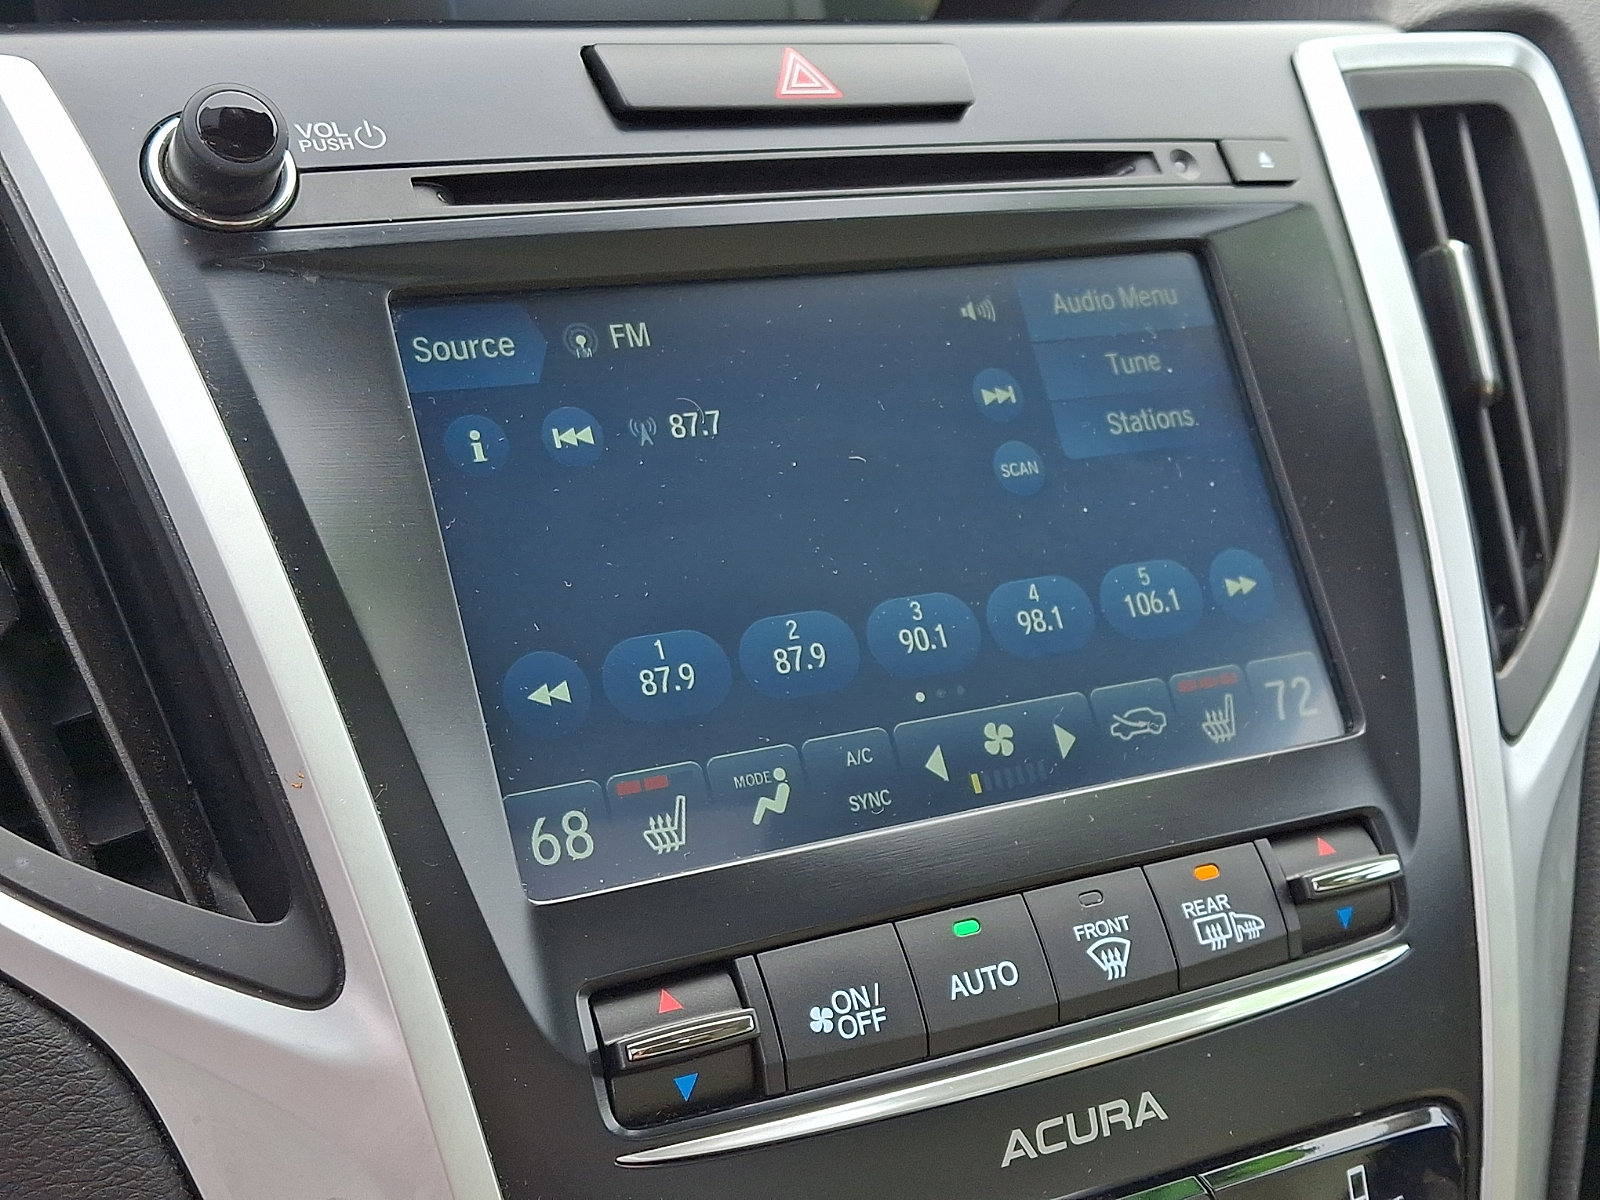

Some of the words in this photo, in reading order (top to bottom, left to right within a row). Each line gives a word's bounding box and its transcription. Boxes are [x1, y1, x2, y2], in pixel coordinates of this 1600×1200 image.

[293, 121, 348, 139] VOL
[298, 137, 355, 153] PUSH
[1053, 288, 1115, 314] Audio
[1117, 284, 1179, 308] Menu
[609, 322, 651, 349] FM
[412, 336, 516, 363] Source
[1104, 352, 1162, 376] Tune
[669, 409, 721, 438] 87.7
[1107, 408, 1195, 435] Stations
[1000, 460, 1040, 478] SCAN
[1137, 566, 1151, 586] 5
[1028, 583, 1040, 602] 4
[1124, 588, 1181, 618] 106.1
[909, 601, 923, 621] 3
[1017, 605, 1064, 635] 98.1
[785, 620, 800, 641] 2
[899, 623, 948, 654] 90.1
[653, 639, 665, 661] 1
[773, 642, 826, 674] 87.9
[639, 663, 696, 696] 87.9
[1264, 676, 1319, 721] 72
[846, 747, 874, 767] A/C
[733, 770, 772, 790] MODE
[848, 789, 892, 813] SYNC
[531, 810, 595, 866] 68
[1181, 894, 1231, 920] REAR
[1073, 914, 1130, 942] FRONT
[950, 961, 1018, 1001] AUTO
[831, 983, 880, 1014] ON/
[837, 1008, 887, 1040] OFF
[1001, 1091, 1169, 1168] ACURA
